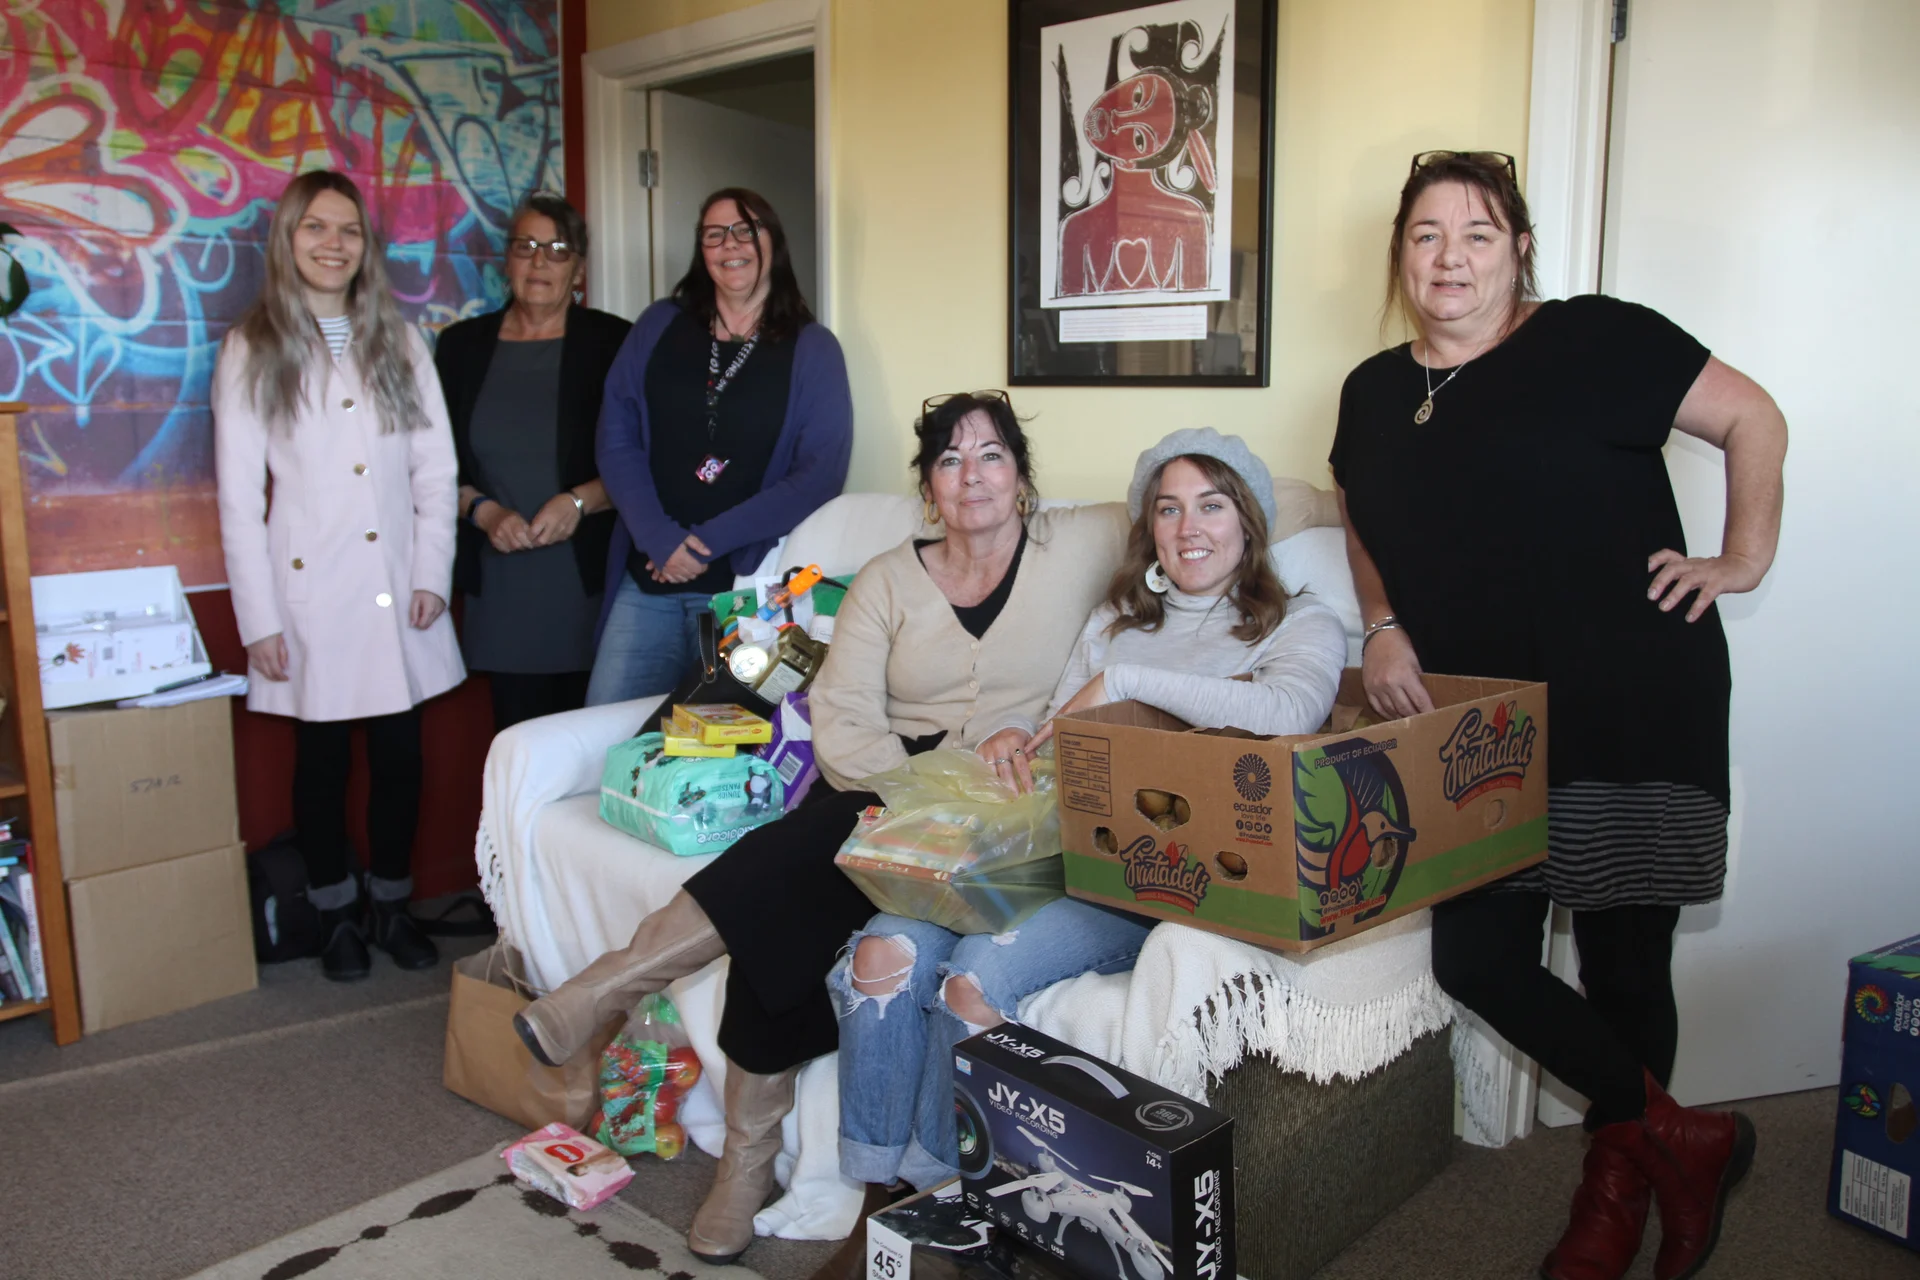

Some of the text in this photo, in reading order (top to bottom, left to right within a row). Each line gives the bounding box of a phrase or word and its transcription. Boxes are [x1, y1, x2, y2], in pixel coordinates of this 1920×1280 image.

[725, 341, 754, 378] KEEPING
[1315, 739, 1398, 769] PRODUCT OF ECUADOR
[1439, 707, 1537, 801] Frutadeli
[1233, 802, 1272, 815] ecuador
[1120, 835, 1211, 900] Frutadeli
[1893, 992, 1906, 1033] ecuador
[986, 1033, 1046, 1058] JY-X5
[988, 1081, 1066, 1135] JY-X5
[988, 1098, 1058, 1139] VIDEO RECORDING
[1145, 1155, 1163, 1170] 14+
[1213, 1169, 1221, 1234] RECORDING
[1194, 1169, 1217, 1280] JY-X5
